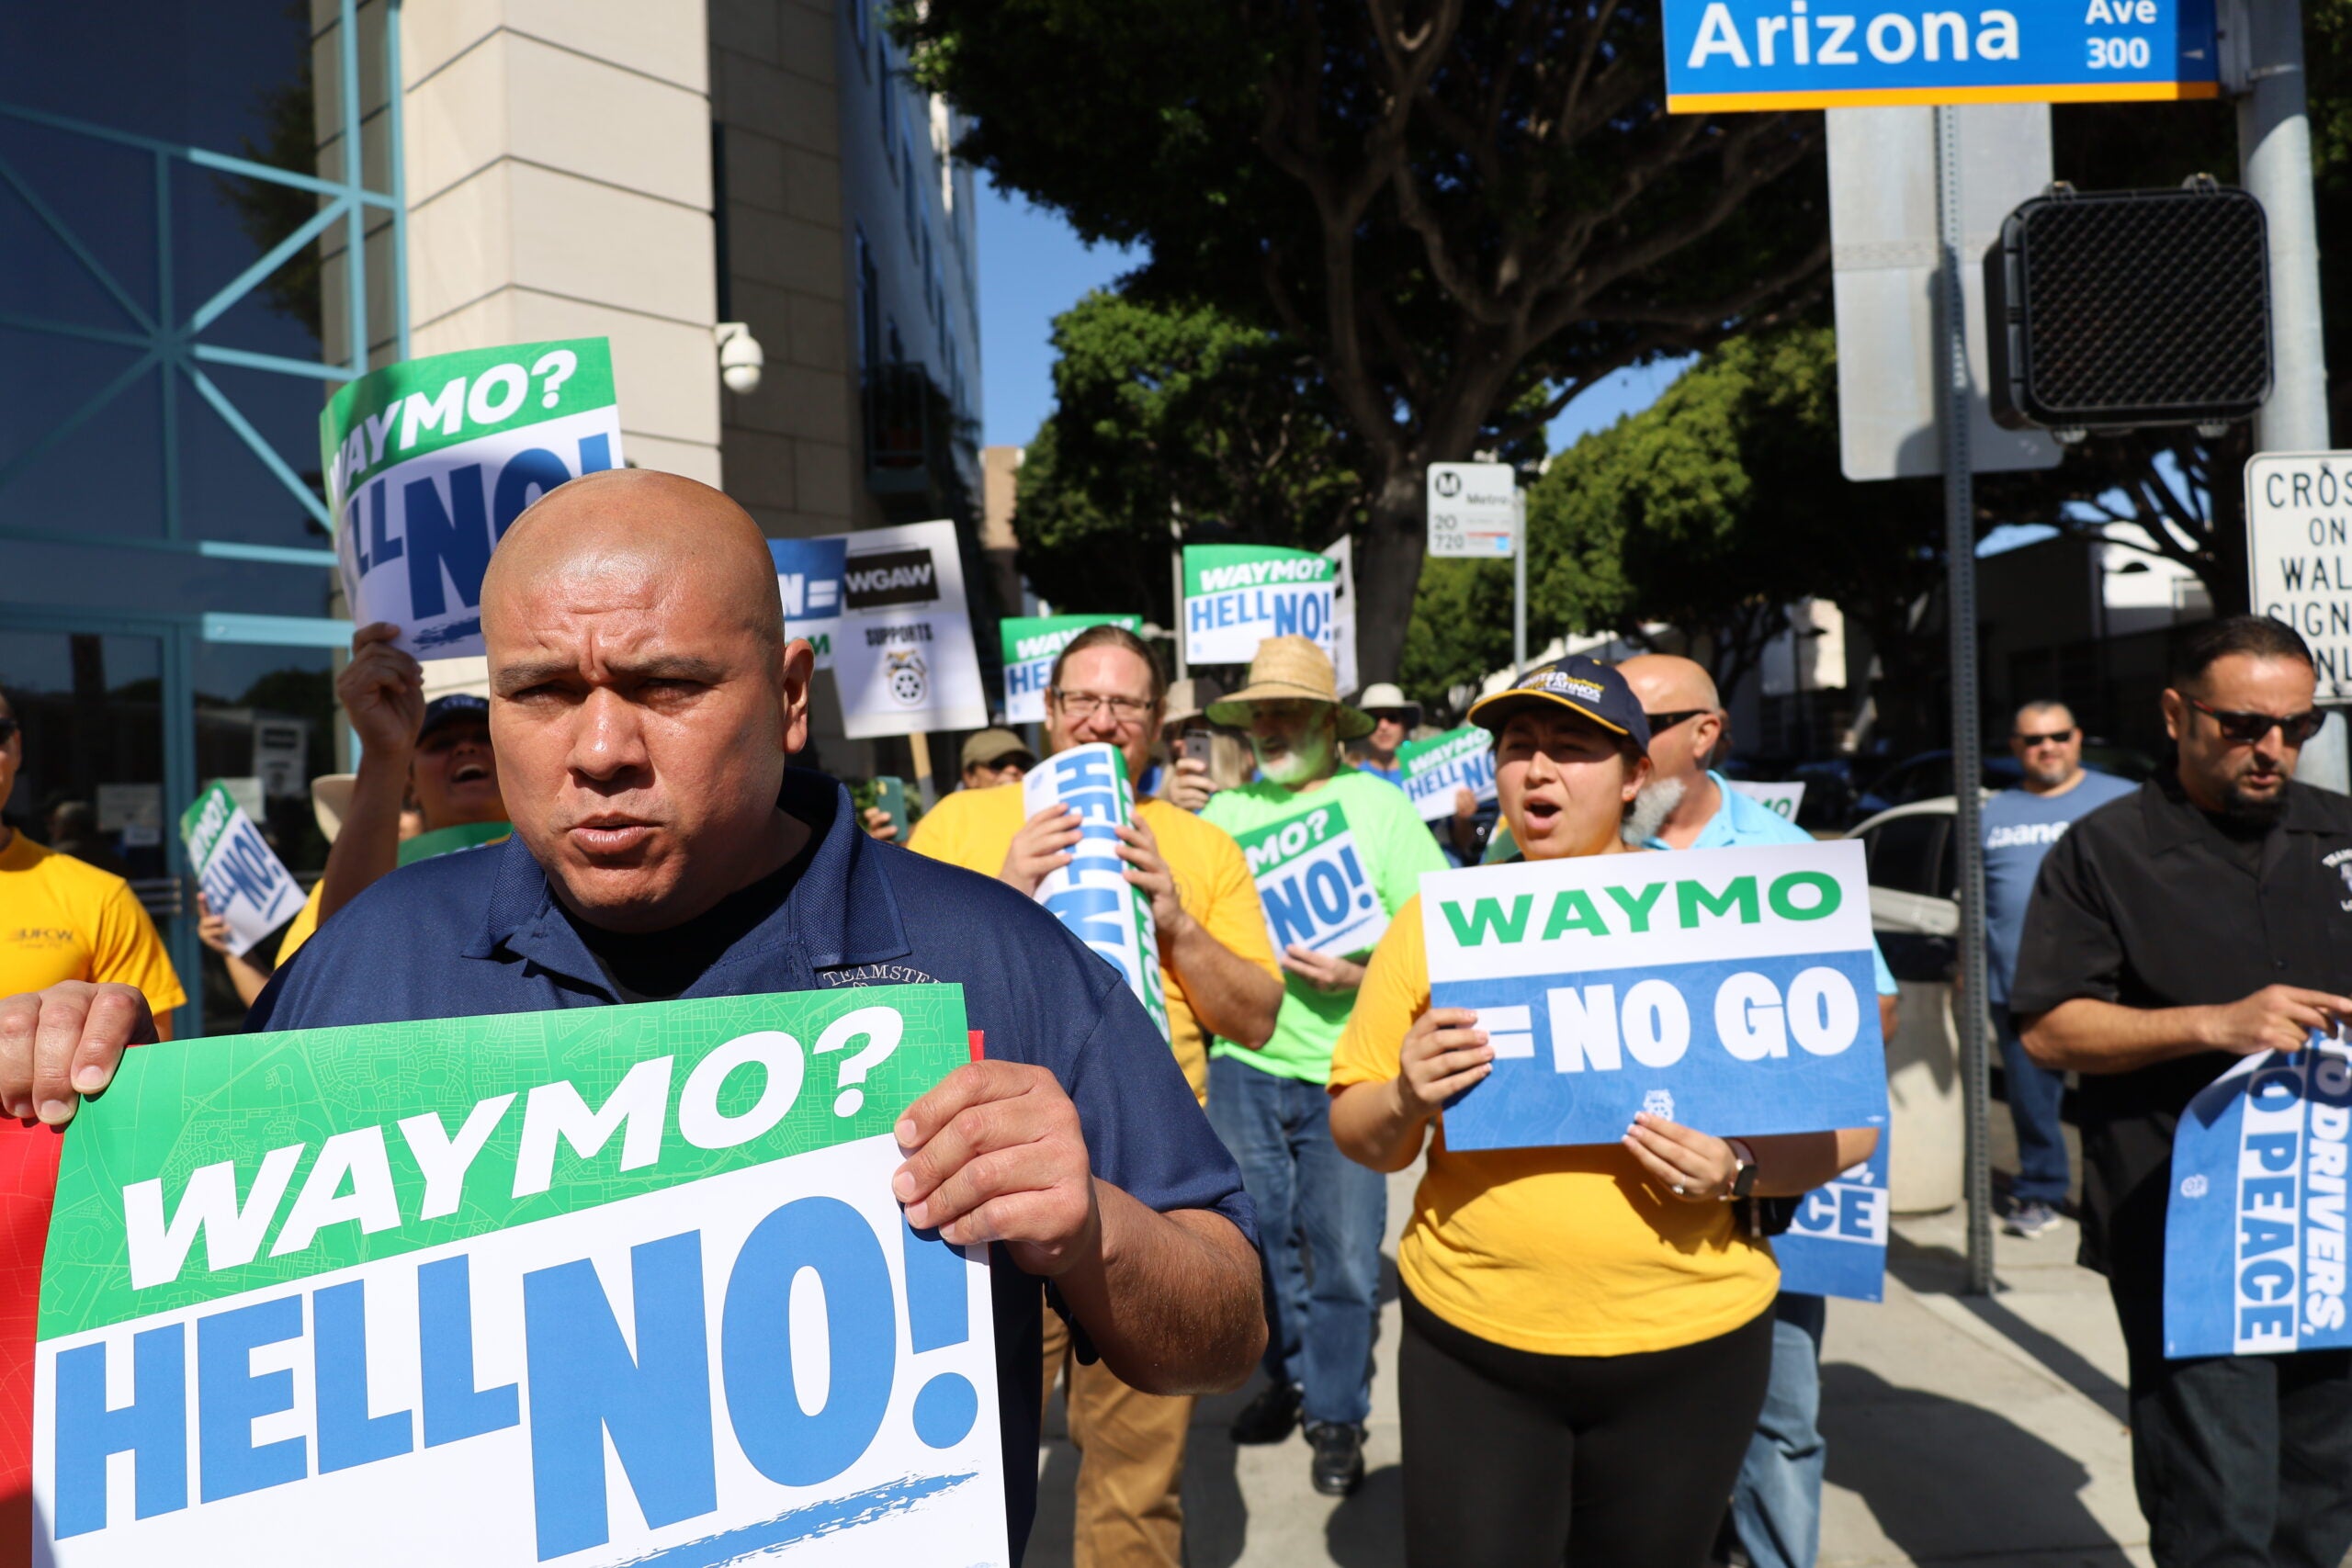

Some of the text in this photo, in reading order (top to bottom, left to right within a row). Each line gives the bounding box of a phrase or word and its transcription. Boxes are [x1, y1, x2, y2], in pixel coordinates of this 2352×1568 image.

[1687, 0, 2158, 69] Arizona Ave
[2086, 37, 2151, 70] 300
[1435, 515, 1456, 530] 20
[1436, 535, 1464, 549] 720
[2310, 517, 2346, 546] ON
[845, 563, 932, 592] WGAW
[1200, 558, 1326, 592] WAYMO?
[865, 622, 933, 647] SUPPORTS
[1192, 591, 1329, 641] HELL NO!
[1406, 761, 1460, 802] HELL
[1261, 844, 1373, 952] NO!
[1441, 870, 1843, 948] WAYMO
[1546, 978, 1692, 1075] NO
[1713, 966, 1860, 1063] GO
[121, 1005, 904, 1292] WAYMO?
[2239, 1131, 2301, 1342] PEACE
[2301, 1106, 2351, 1337] DRIVERS,
[54, 1195, 979, 1563] HELL NO!
